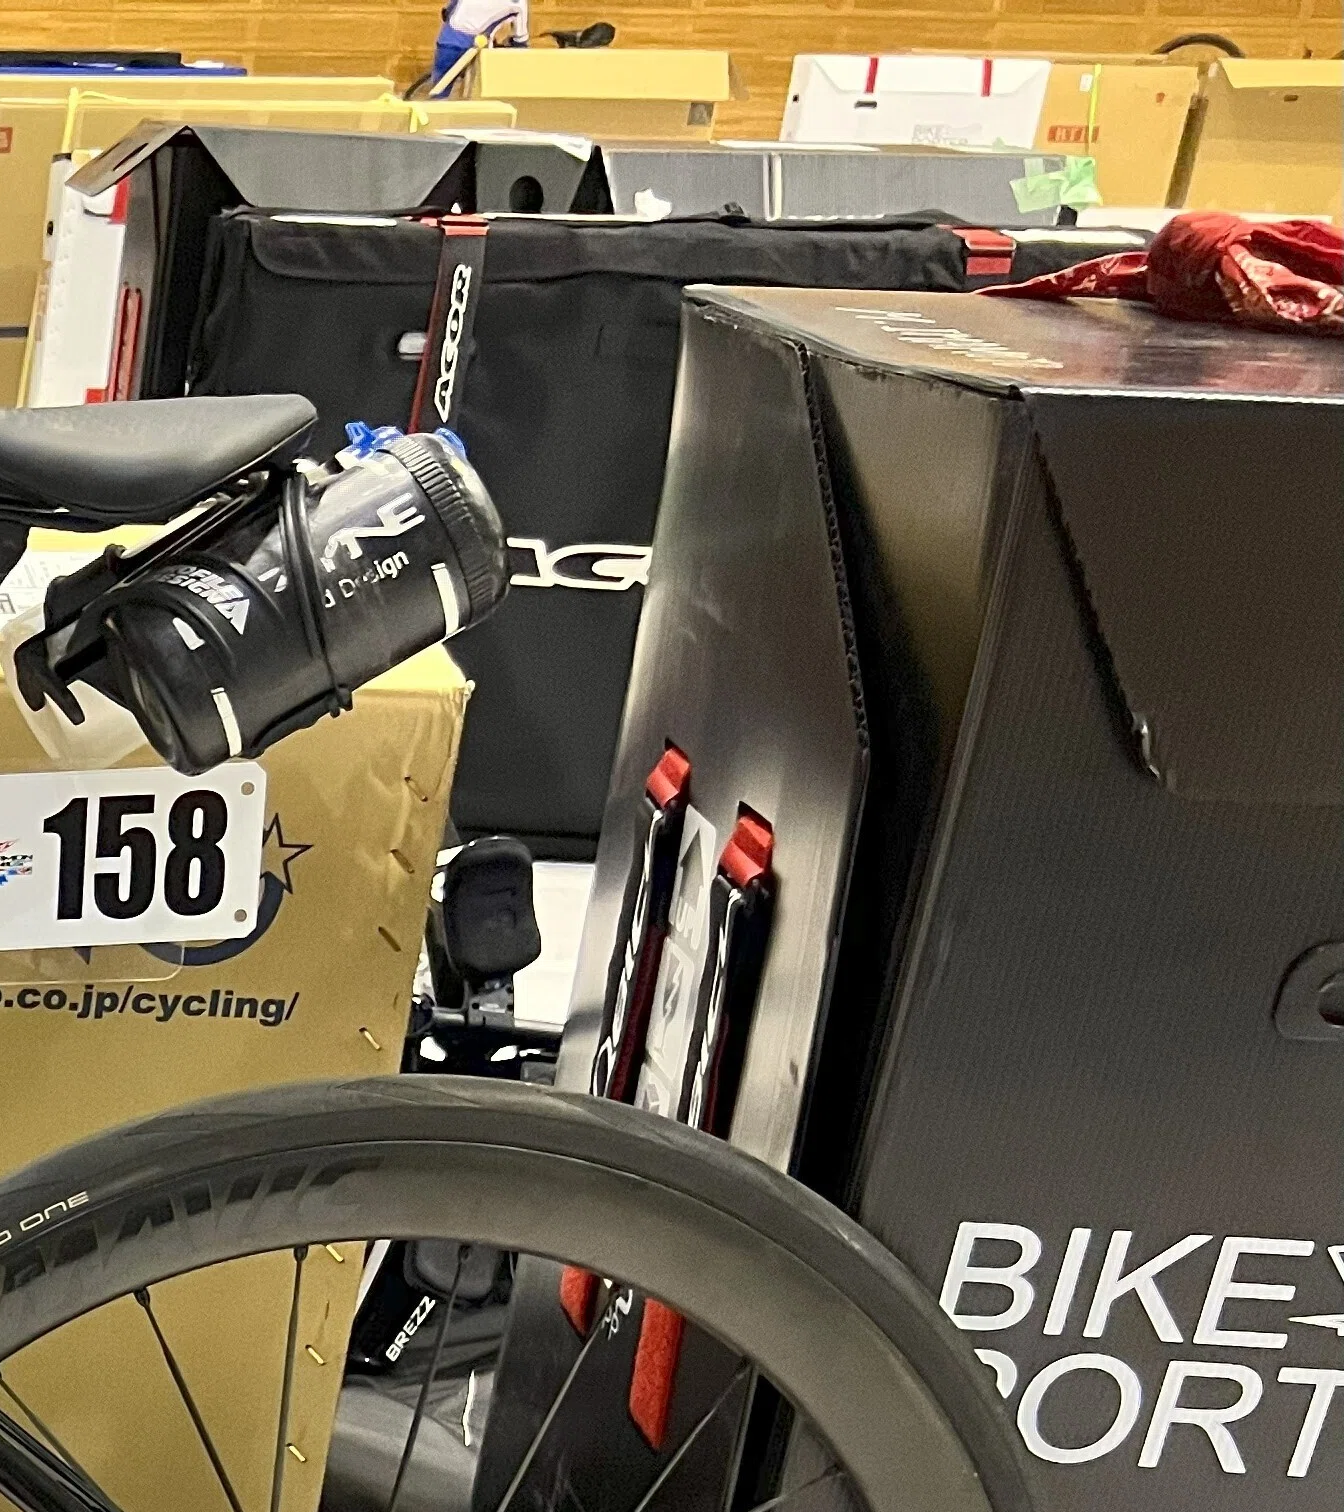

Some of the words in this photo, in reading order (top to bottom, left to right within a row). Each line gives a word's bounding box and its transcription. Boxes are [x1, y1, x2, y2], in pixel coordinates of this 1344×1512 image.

[435, 264, 472, 423] ACOR
[42, 789, 229, 921] 158
[940, 1221, 1316, 1349] BIKE
